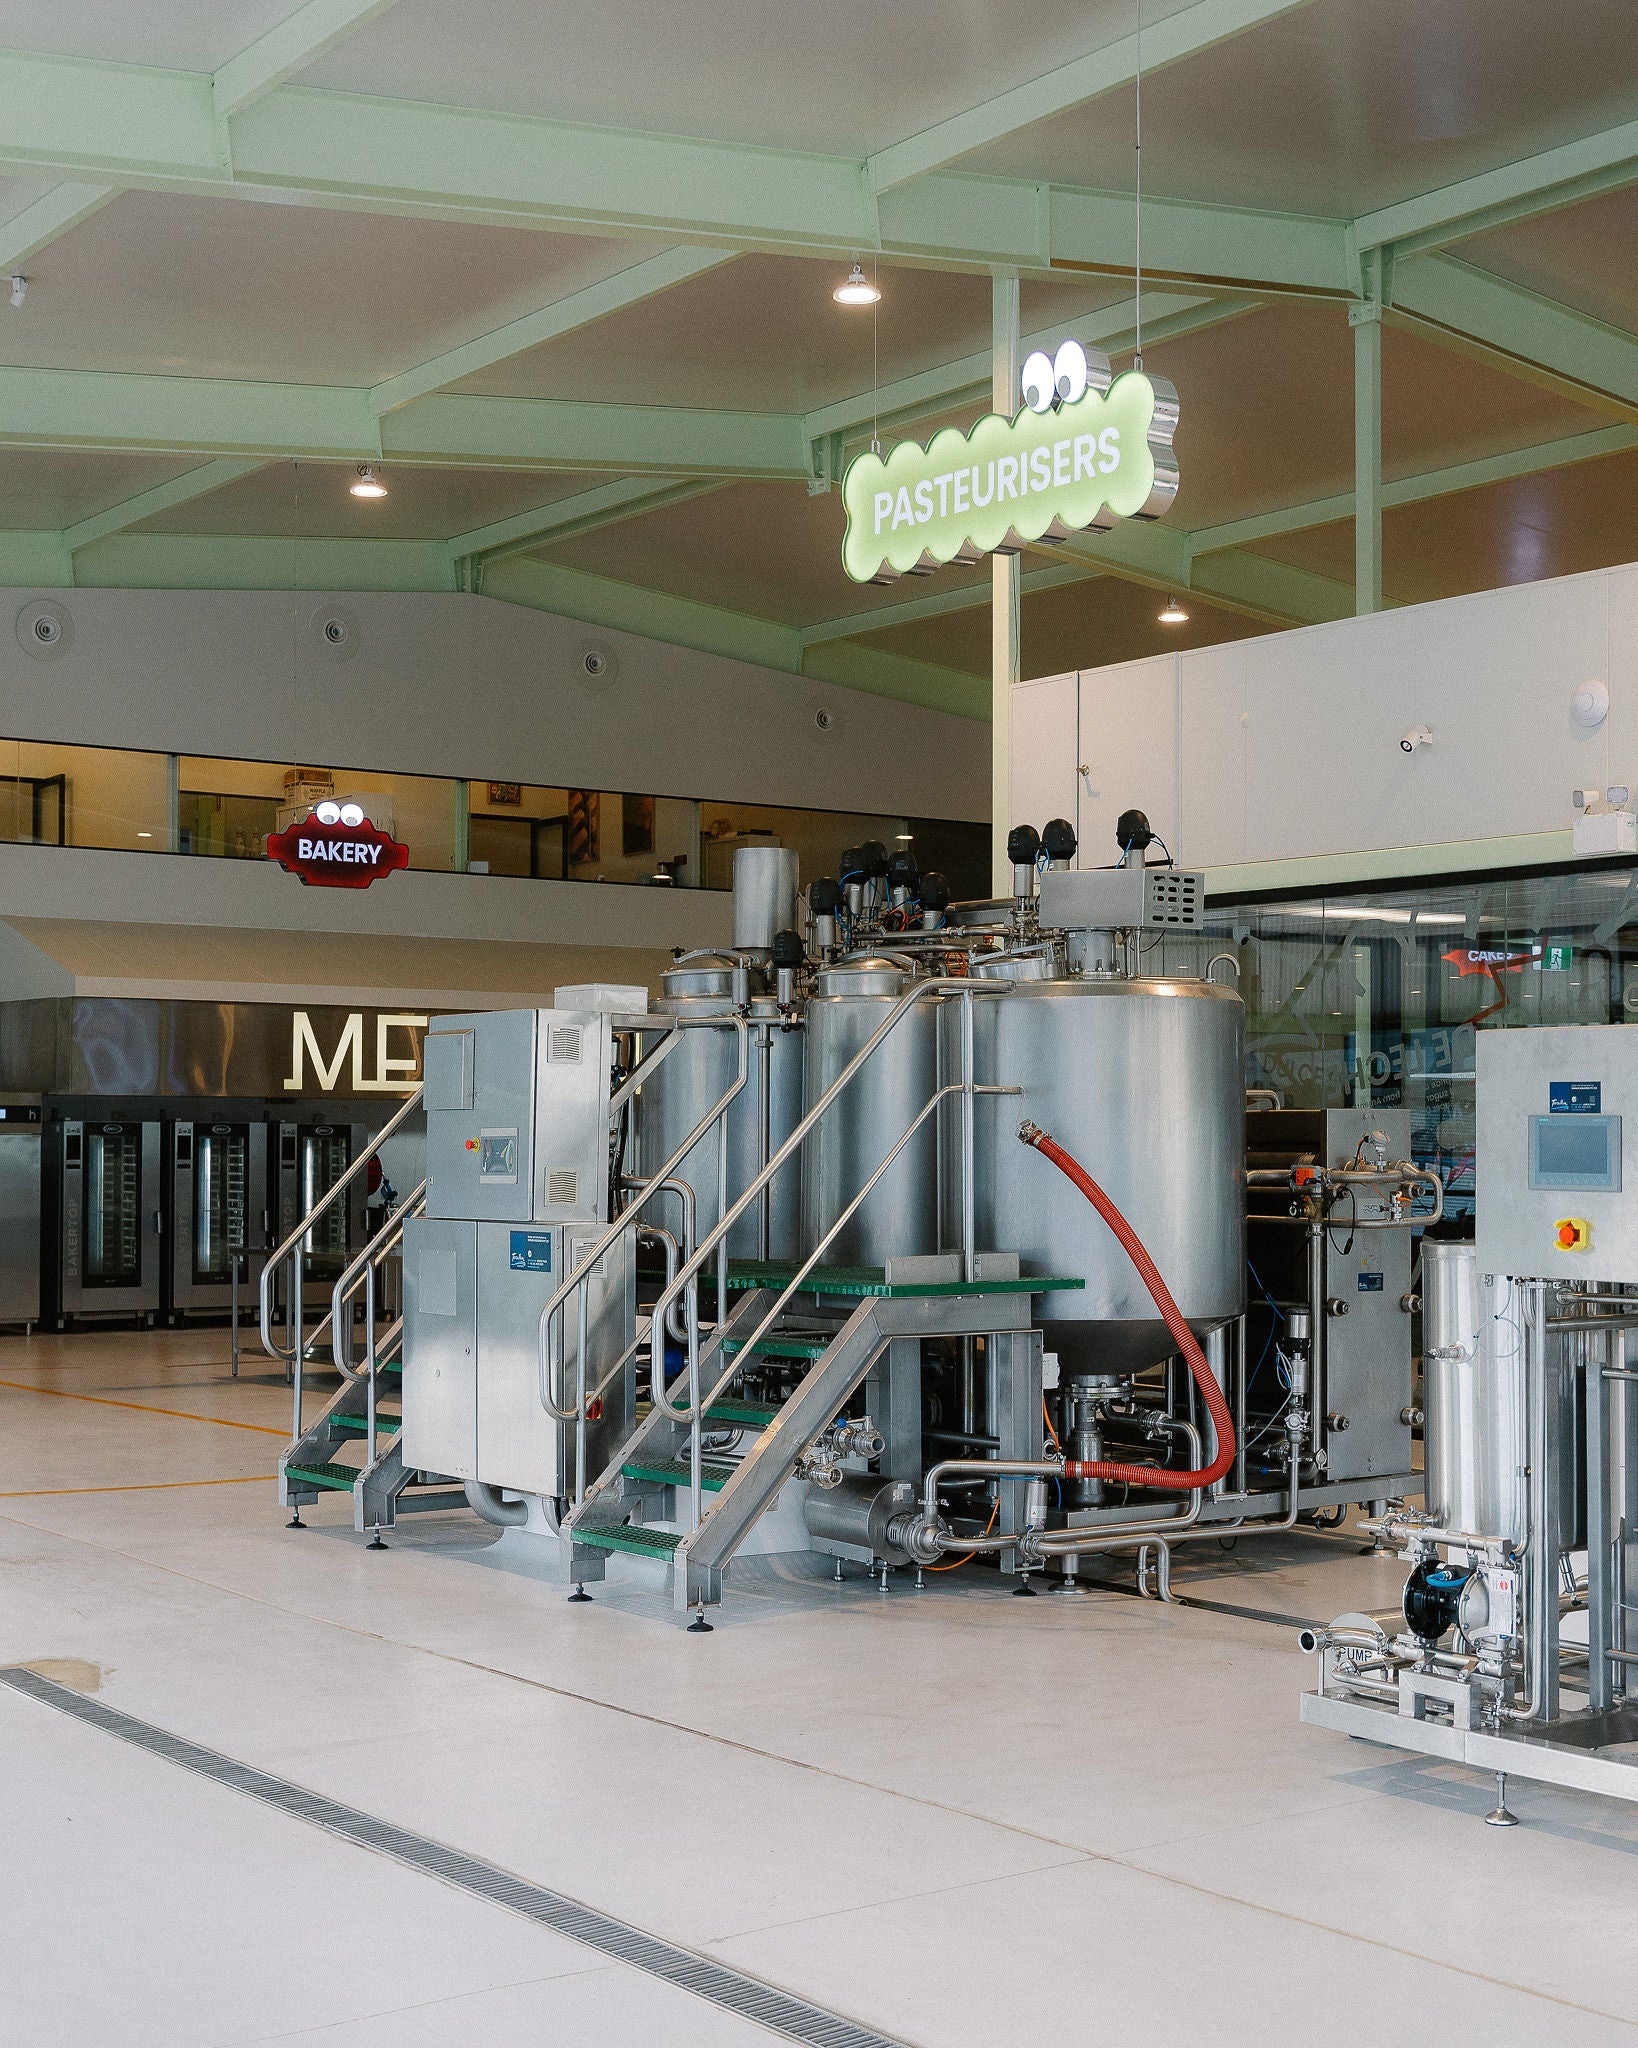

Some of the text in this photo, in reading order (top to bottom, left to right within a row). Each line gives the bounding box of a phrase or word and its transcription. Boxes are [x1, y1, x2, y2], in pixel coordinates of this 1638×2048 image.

[873, 426, 1122, 535] PASTEURISERS
[298, 838, 383, 865] BAKERY
[67, 1198, 78, 1276] BAKERTOP
[1339, 1646, 1373, 1662] PUMP
